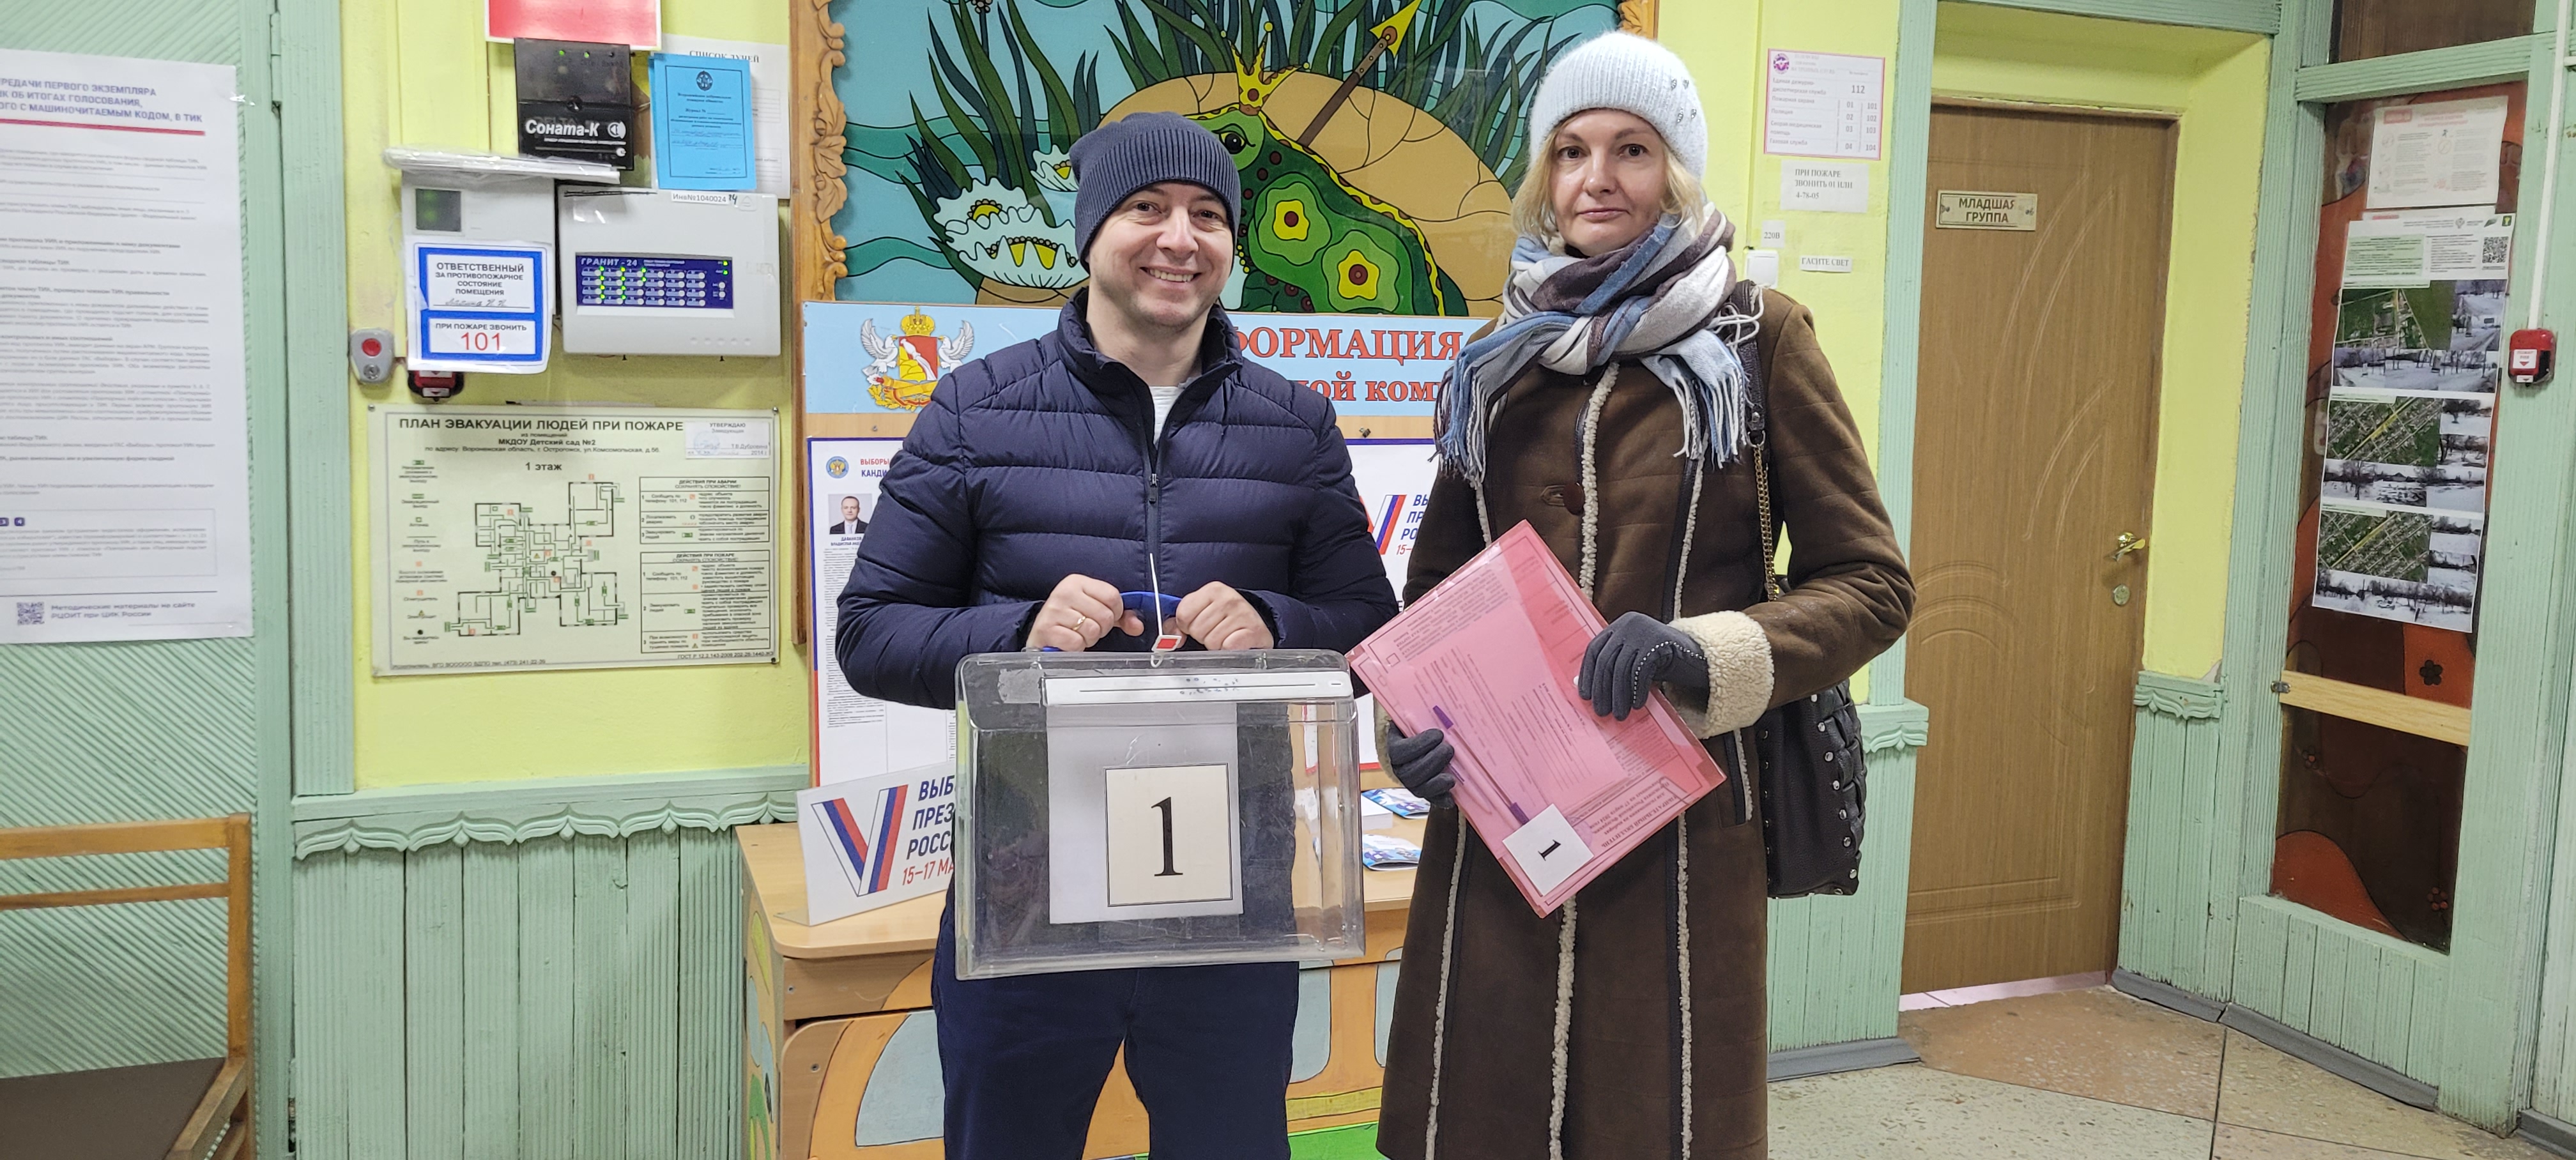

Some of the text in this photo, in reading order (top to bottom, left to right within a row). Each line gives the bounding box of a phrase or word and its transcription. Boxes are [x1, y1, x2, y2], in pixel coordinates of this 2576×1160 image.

[45, 81, 89, 91] ПЕРВОГО
[92, 84, 157, 96] ЭКЗЕМПЛЯРА
[1851, 85, 1865, 94] 112
[27, 92, 66, 102] ИТОГАХ
[69, 95, 142, 107] ГОЛОСОВАНИЯ,
[29, 104, 132, 118] МАШИНОЧИТАЕМЫМ
[135, 111, 172, 121] КОДОМ,
[183, 114, 203, 123] ТИК
[525, 119, 600, 137] Соната-К
[1811, 169, 1841, 178] ПОЖАРЕ
[1795, 179, 1827, 188] ЗВОНИТЬ
[673, 194, 726, 202] Инв№1040024
[1966, 211, 2009, 223] ГРУППА
[437, 263, 524, 273] ОТВЕТСТВЕННЫЙ
[461, 332, 500, 351] 101
[1365, 381, 1439, 402] ком
[400, 418, 684, 431] ПЛАН ЭВАКУАЦИИ ЛЮДЕЙ ПРИ ПОЖАРЕ
[1151, 797, 1183, 876] 1
[1538, 839, 1561, 861] 1
